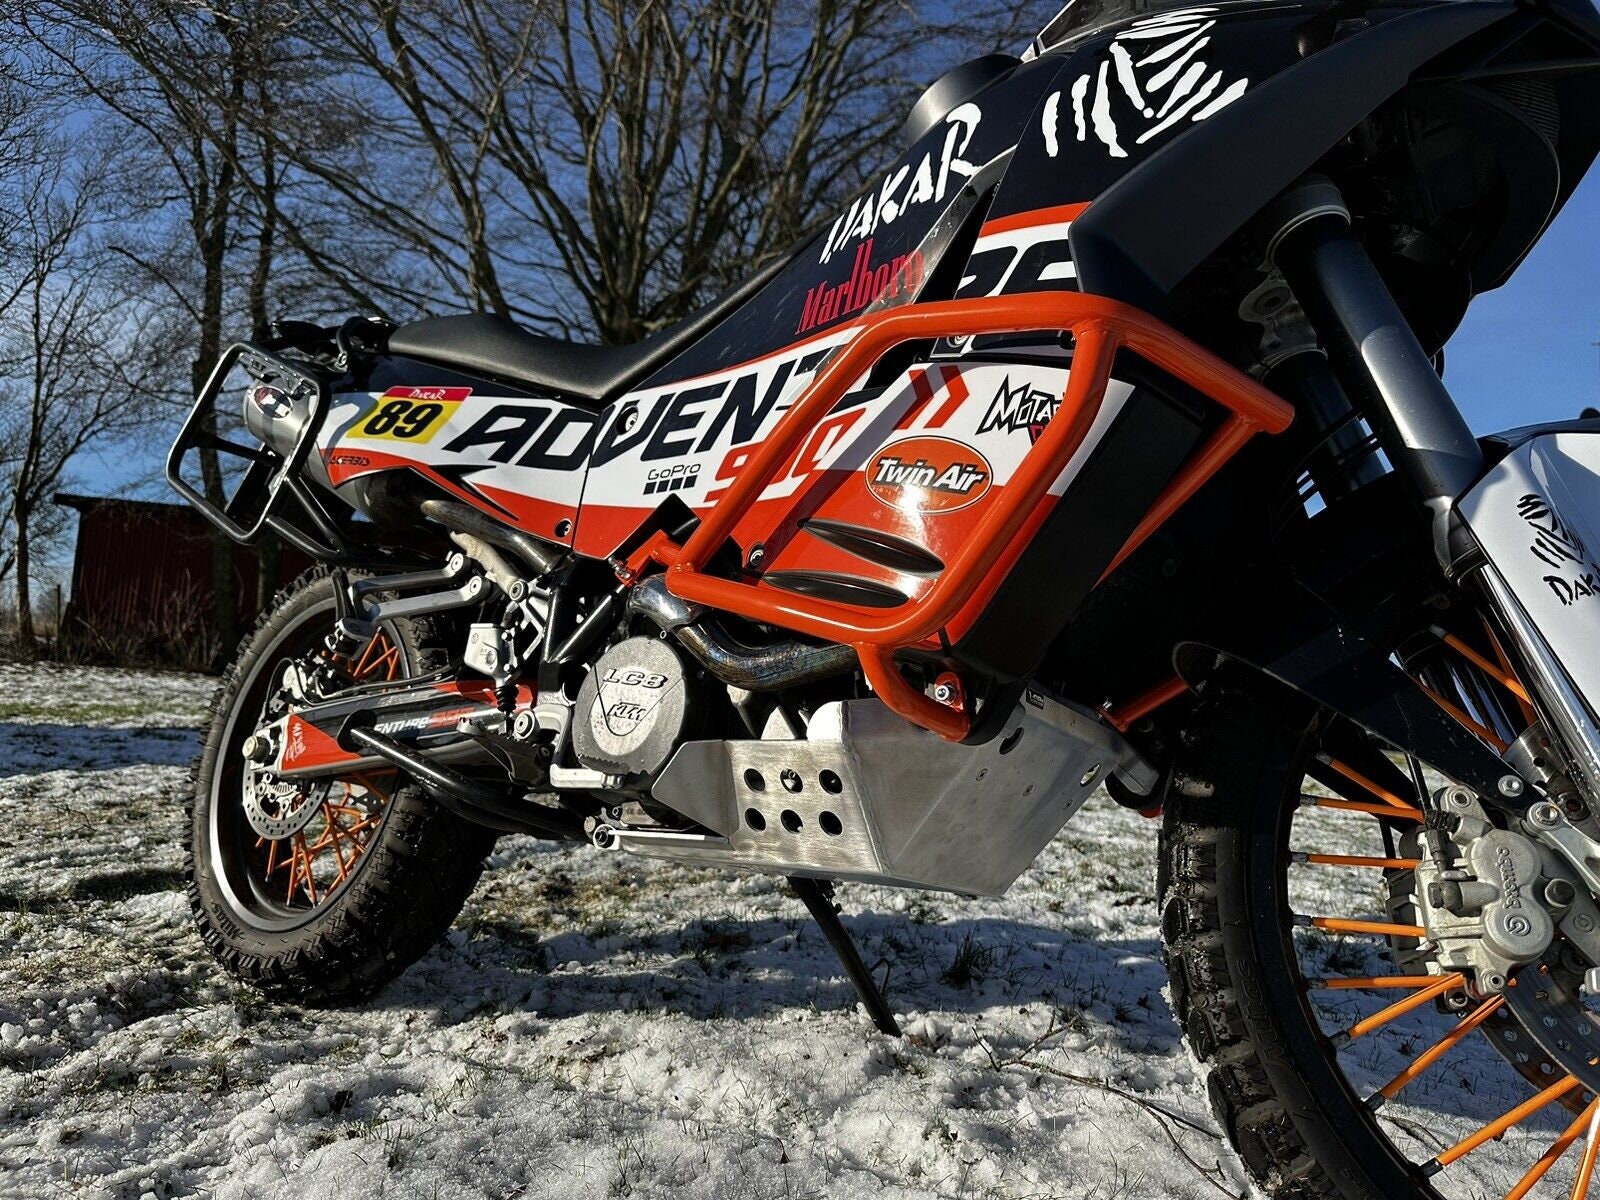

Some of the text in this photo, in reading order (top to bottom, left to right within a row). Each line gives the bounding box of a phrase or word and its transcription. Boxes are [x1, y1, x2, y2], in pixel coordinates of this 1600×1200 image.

[795, 238, 924, 335] Marlboro
[363, 400, 444, 438] 89
[648, 463, 701, 481] GoPro
[874, 457, 987, 493] Twin Air
[602, 668, 668, 689] LC8
